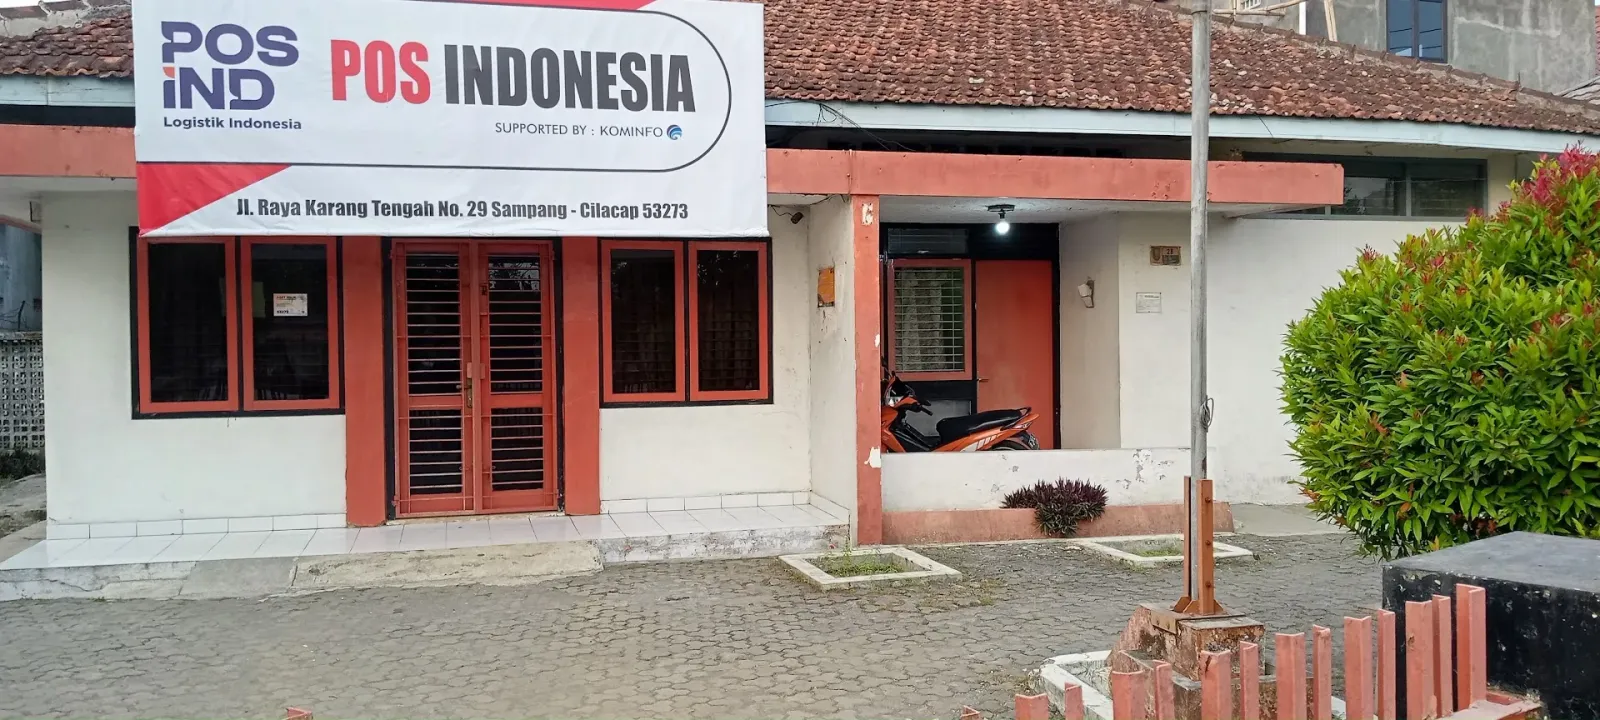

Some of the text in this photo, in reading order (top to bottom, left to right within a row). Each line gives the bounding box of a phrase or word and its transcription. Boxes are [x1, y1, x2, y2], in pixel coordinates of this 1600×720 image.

[161, 21, 299, 67] POS
[330, 39, 696, 113] POS INDONESIA
[163, 116, 302, 130] Logistik Indonesia
[495, 122, 568, 135] SUPPORTED
[572, 124, 587, 135] BY
[600, 125, 663, 138] KOMINFO
[236, 198, 254, 216] Jl.
[257, 199, 301, 218] Raya
[305, 199, 368, 218] Karang
[371, 200, 435, 219] Tengah
[438, 200, 464, 217] No.
[467, 200, 488, 217] 29
[491, 201, 568, 220] Sampang
[580, 202, 639, 220] Cilacap
[642, 203, 689, 219] 53273
